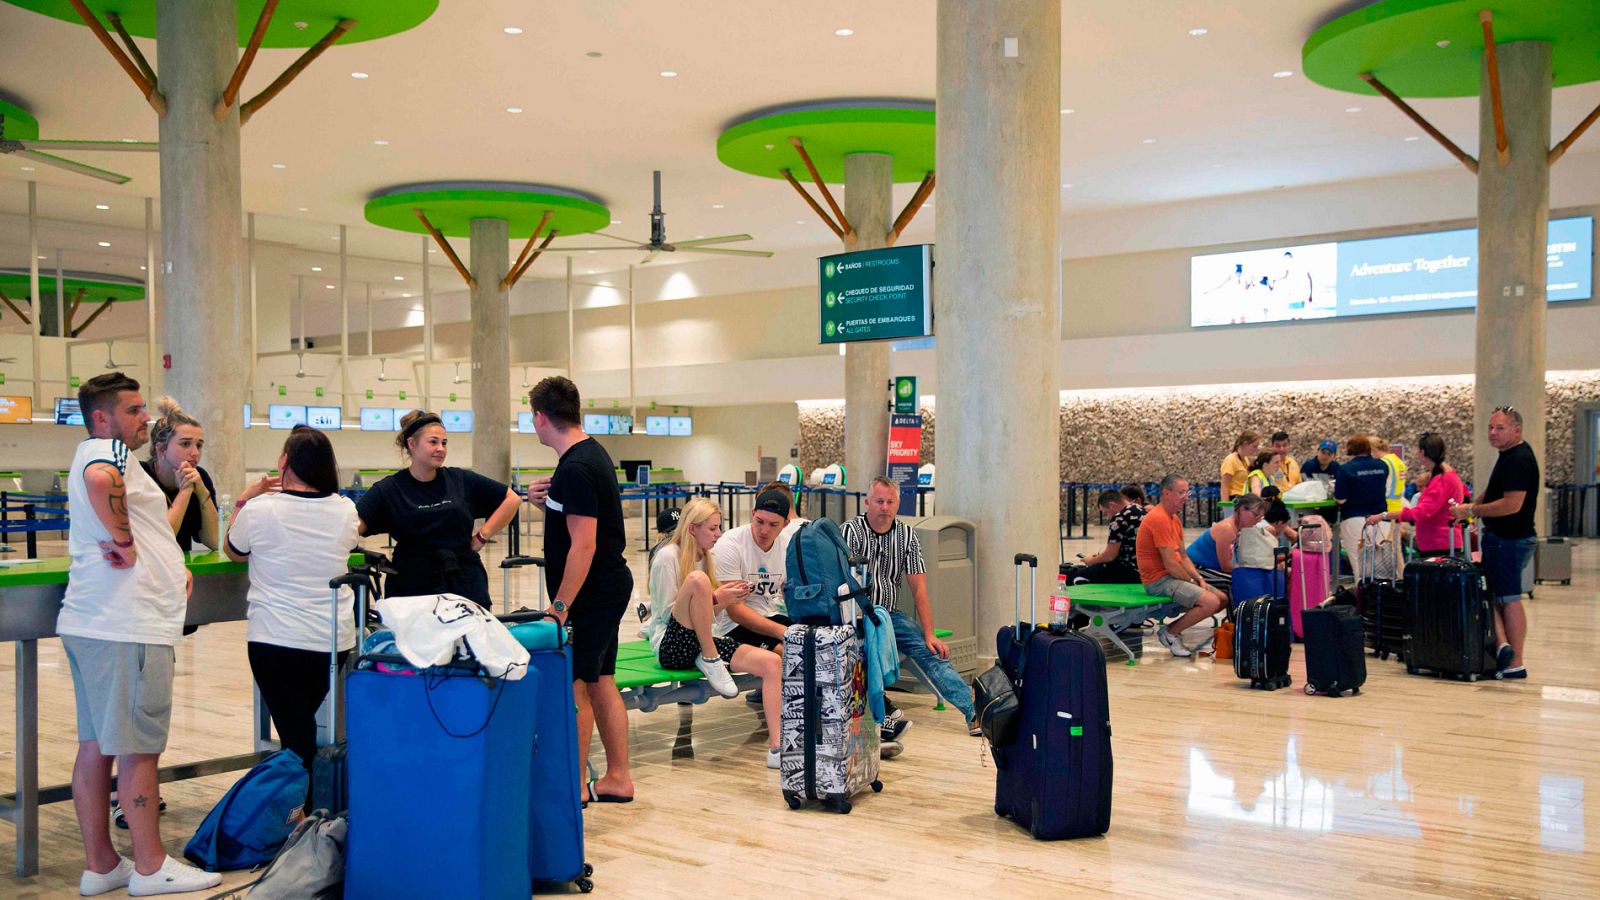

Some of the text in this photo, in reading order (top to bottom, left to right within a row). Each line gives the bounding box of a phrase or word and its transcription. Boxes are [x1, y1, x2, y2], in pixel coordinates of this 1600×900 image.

[845, 262, 862, 270] BAÑOS
[865, 258, 899, 267] RESTROOMS
[1350, 255, 1470, 276] Adventure Together
[845, 288, 869, 296] CHEQUEO
[879, 284, 914, 292] SEGURIDAD
[845, 292, 906, 304] SECURITY CHECK POINT
[846, 318, 868, 326] PUERTAS
